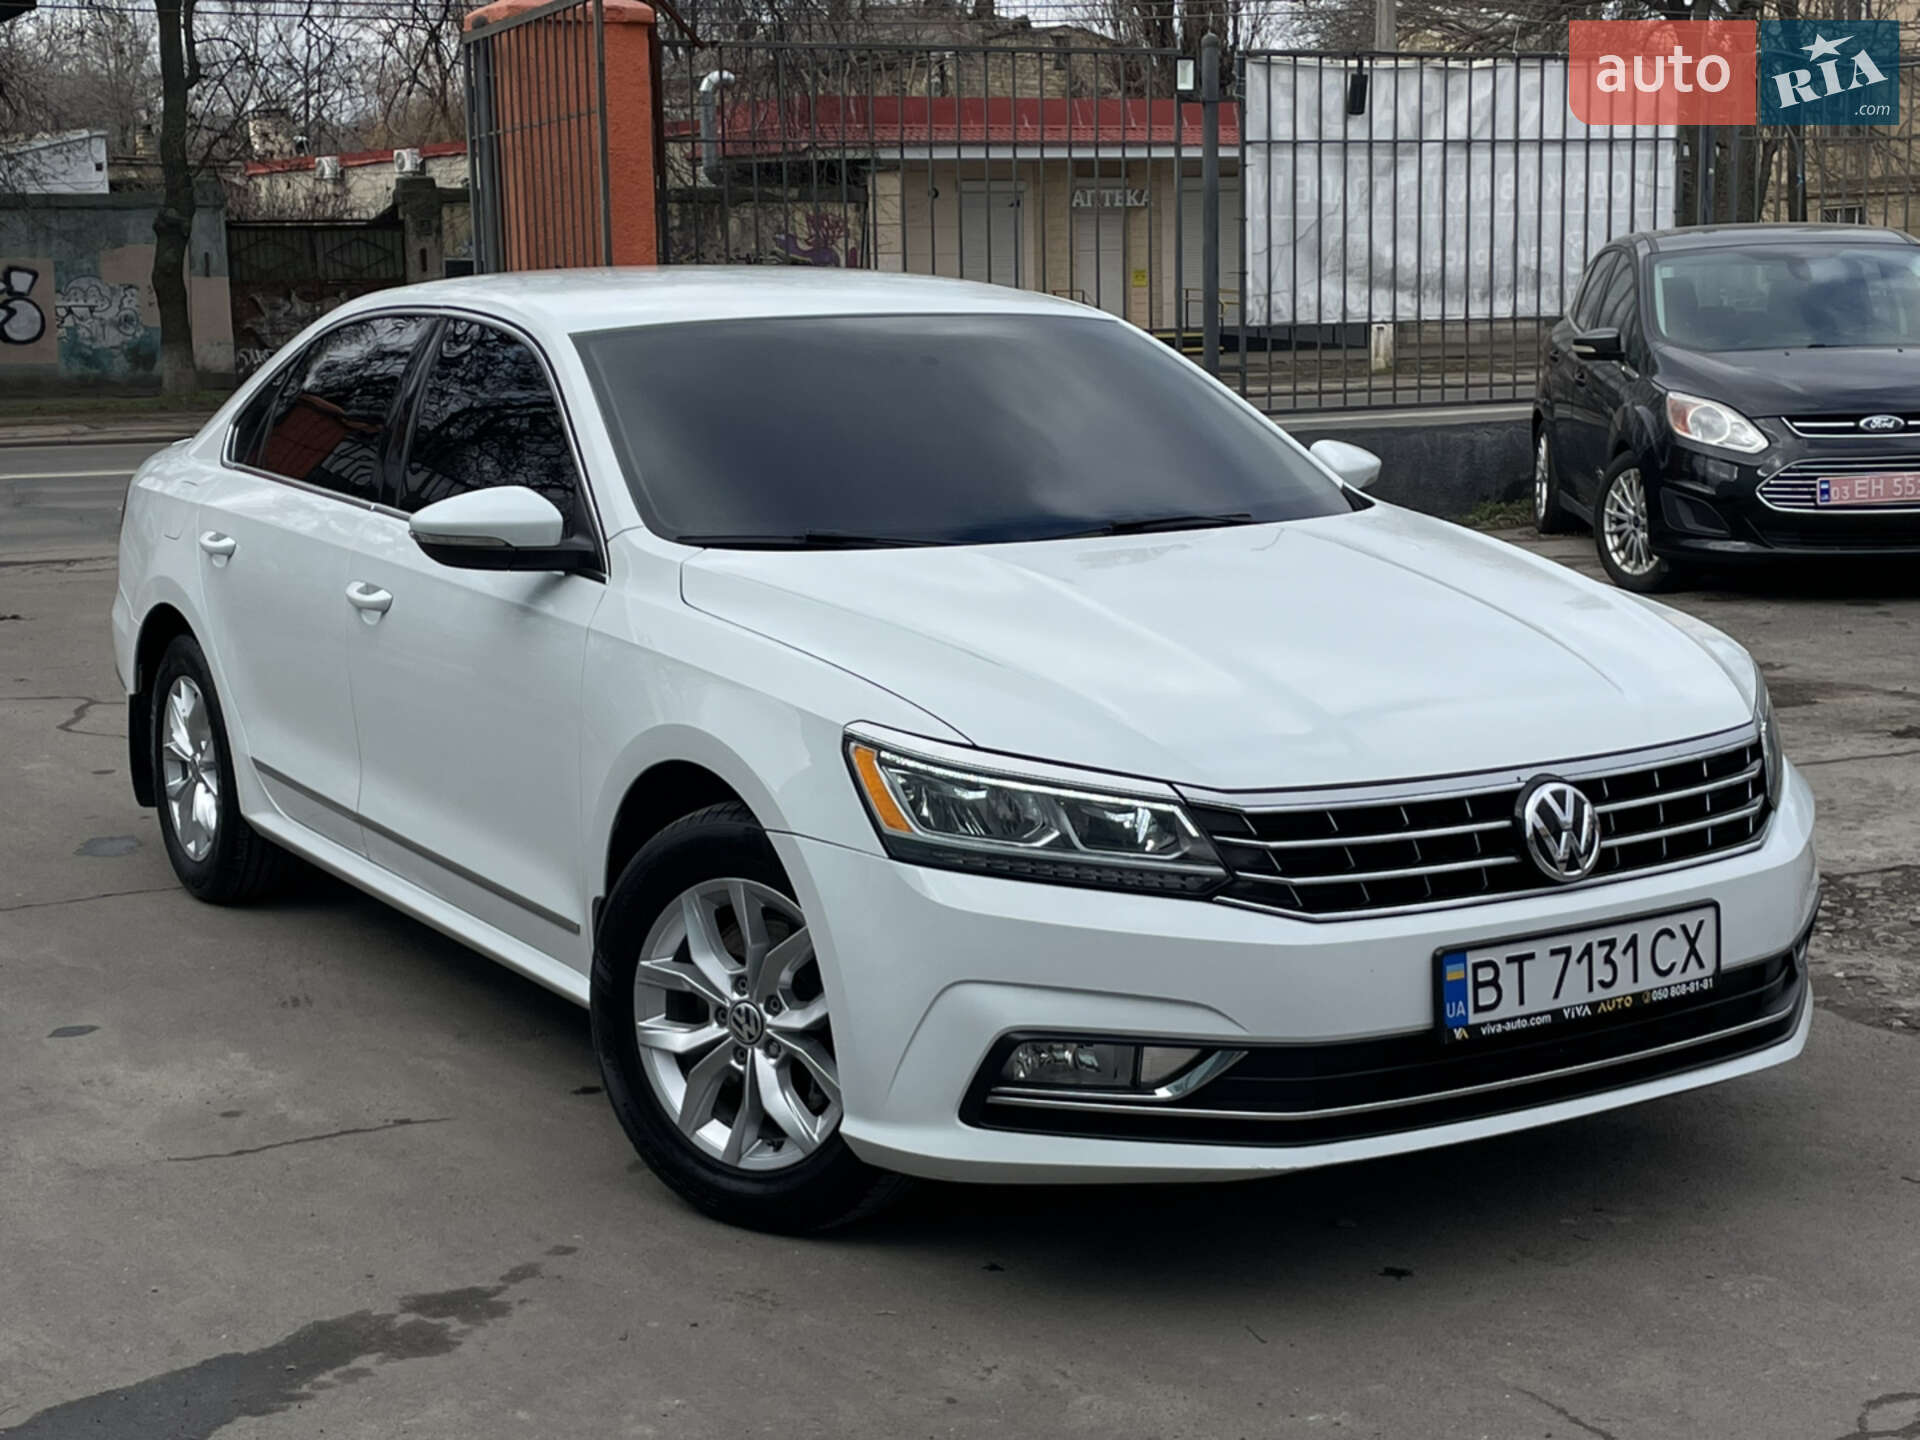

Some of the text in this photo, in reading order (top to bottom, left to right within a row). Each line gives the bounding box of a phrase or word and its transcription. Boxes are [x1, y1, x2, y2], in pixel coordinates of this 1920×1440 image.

[1471, 919, 1705, 1014] BT 7131 CX
[1446, 1001, 1466, 1019] UA
[1597, 995, 1633, 1014] AUTO
[1480, 1014, 1552, 1035] viva-auto.com
